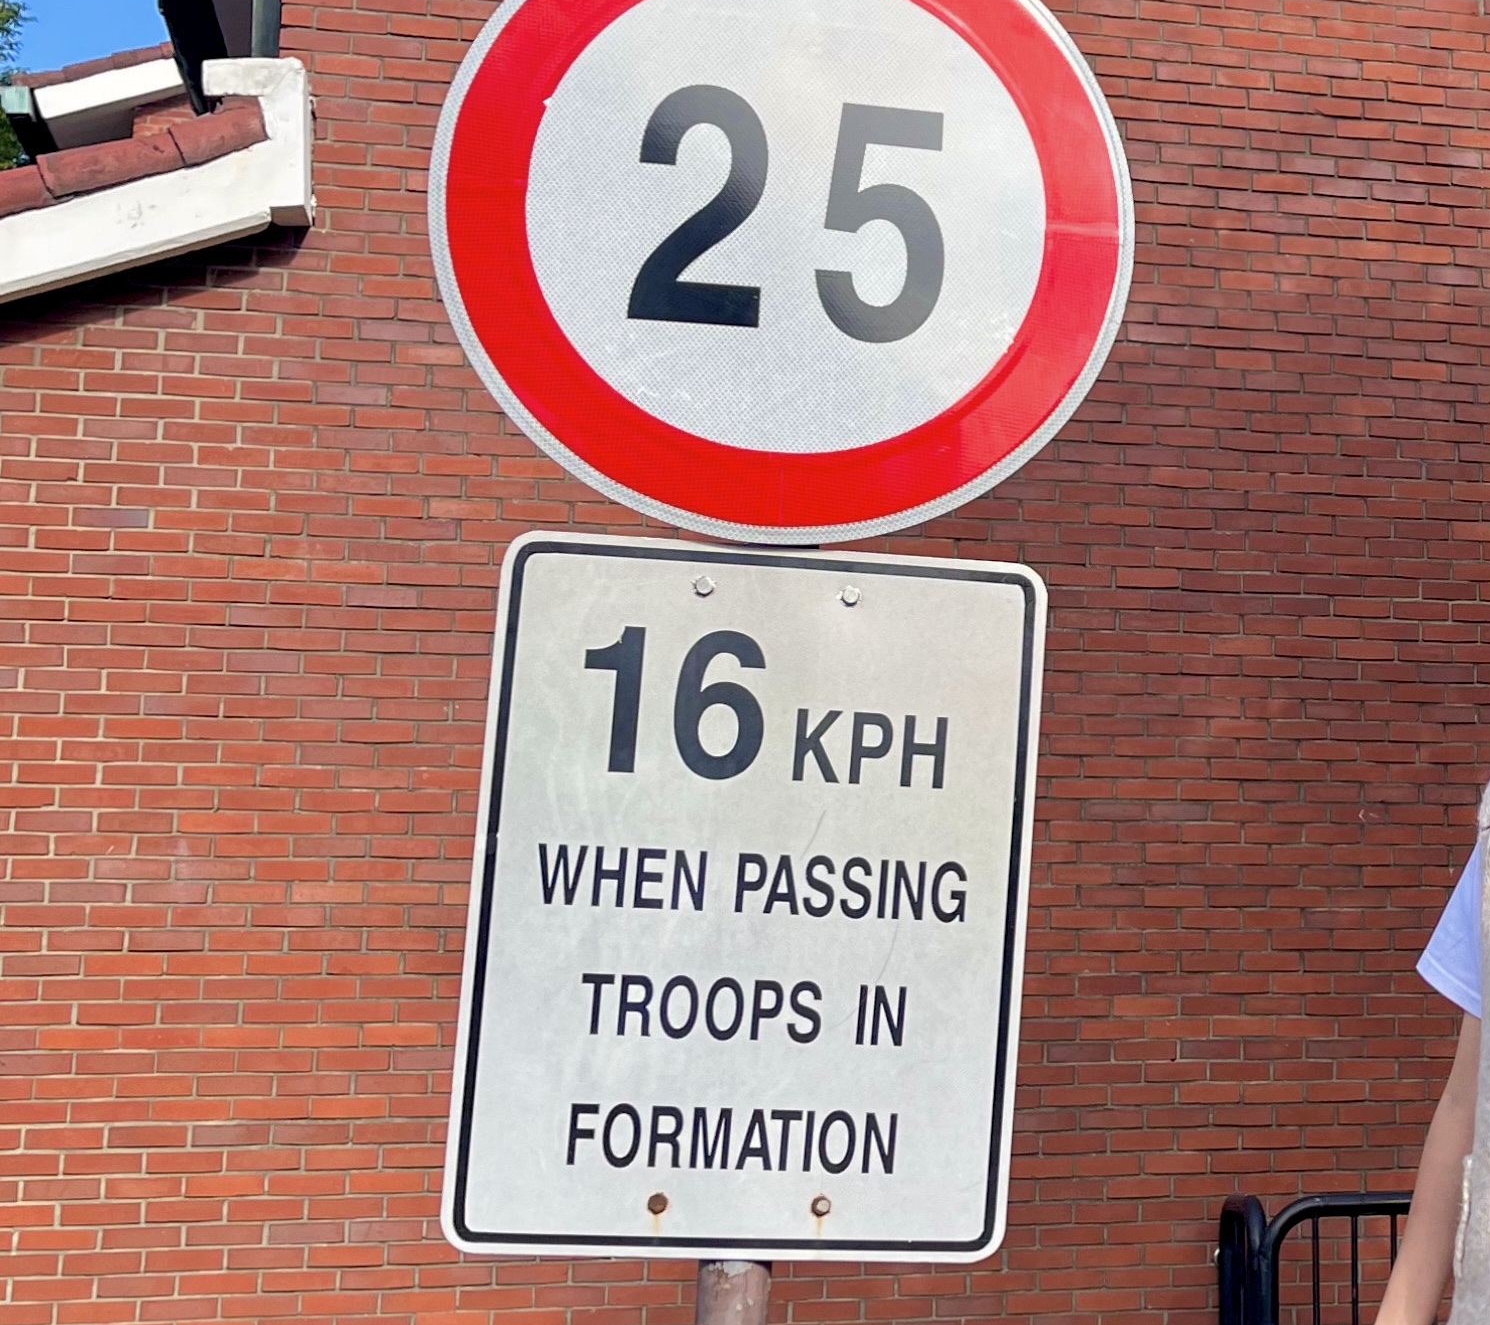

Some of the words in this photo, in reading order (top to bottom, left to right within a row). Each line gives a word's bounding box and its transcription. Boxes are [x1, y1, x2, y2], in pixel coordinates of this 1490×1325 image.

[627, 85, 945, 344] 25
[583, 625, 767, 781] 16
[791, 708, 949, 790] KPH
[538, 843, 708, 912] WHEN
[734, 852, 968, 924] PASSING
[581, 972, 823, 1045] TROOPS
[855, 984, 907, 1047] IN
[566, 1102, 898, 1175] FORMATION
